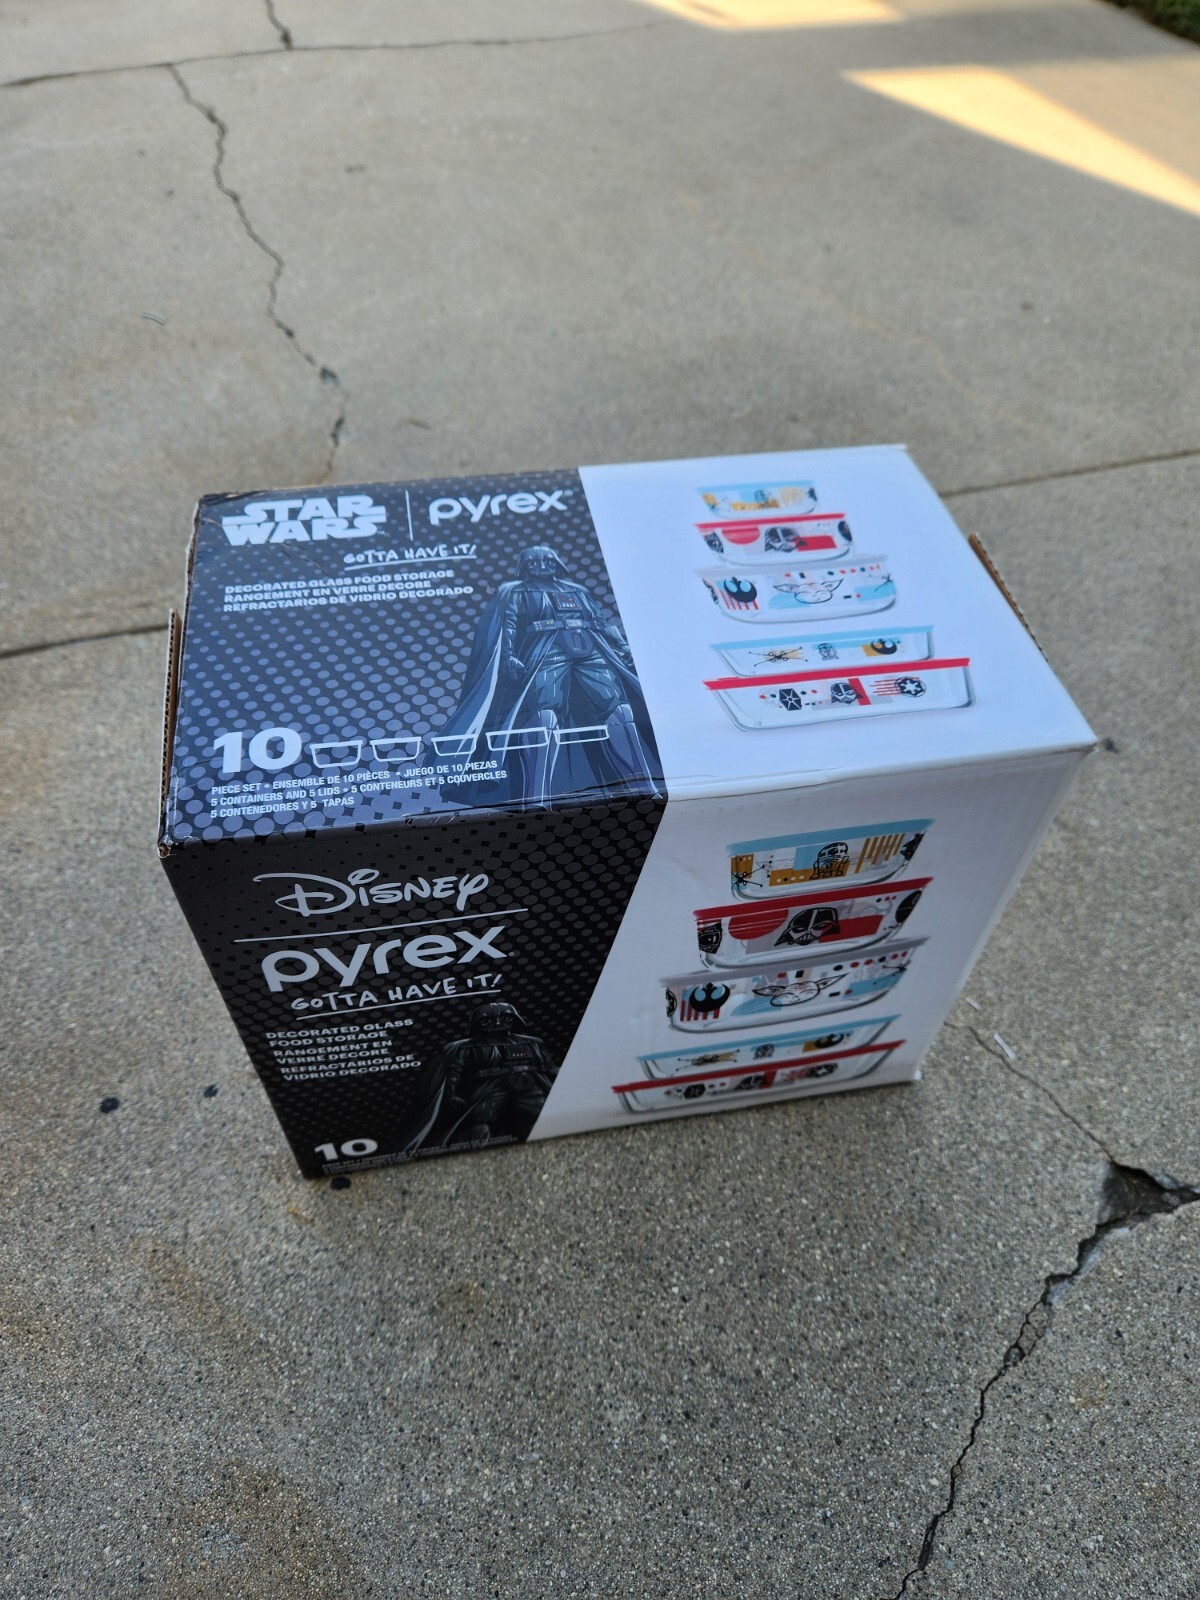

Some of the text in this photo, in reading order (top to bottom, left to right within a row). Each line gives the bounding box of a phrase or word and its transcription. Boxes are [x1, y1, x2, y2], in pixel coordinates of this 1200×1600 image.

[222, 495, 387, 525] STAR
[429, 489, 568, 525] pyrex
[222, 514, 387, 546] WARS
[343, 543, 477, 564] GOTTA HAVE IT!
[224, 580, 432, 603] RANGEMENT EN VERRE DECORE
[225, 569, 455, 594] DECORATED GLASS FOOD STORAGE
[223, 586, 474, 612] REFRACTARIOS DE VIDRIO DECORADO
[213, 727, 302, 773] 10
[210, 770, 508, 807] 5 CONTAINERS AND 5 LIDS 5 CONTENEURS ET 5 COUVERCLES
[211, 760, 498, 795] PIECE SET ENSEMBLE DE 10 PIÈCES JUEGO DE 10 PIEZAS
[210, 796, 354, 819] 5 CONTENEDORES Y 5 TAPAS
[261, 926, 508, 992] pyrex
[290, 973, 503, 1011] GOTTA HAVE IT!
[265, 1018, 414, 1040] DECORATED GLASS
[269, 1030, 389, 1047] FOOD STORAGE
[273, 1039, 393, 1057] RANGEMENT EN
[276, 1048, 389, 1065] VERRE DECORE
[280, 1053, 415, 1074] REFRACTARIOS DE
[283, 1060, 422, 1081] VIDRIO DECORADO
[314, 1138, 378, 1161] 10
